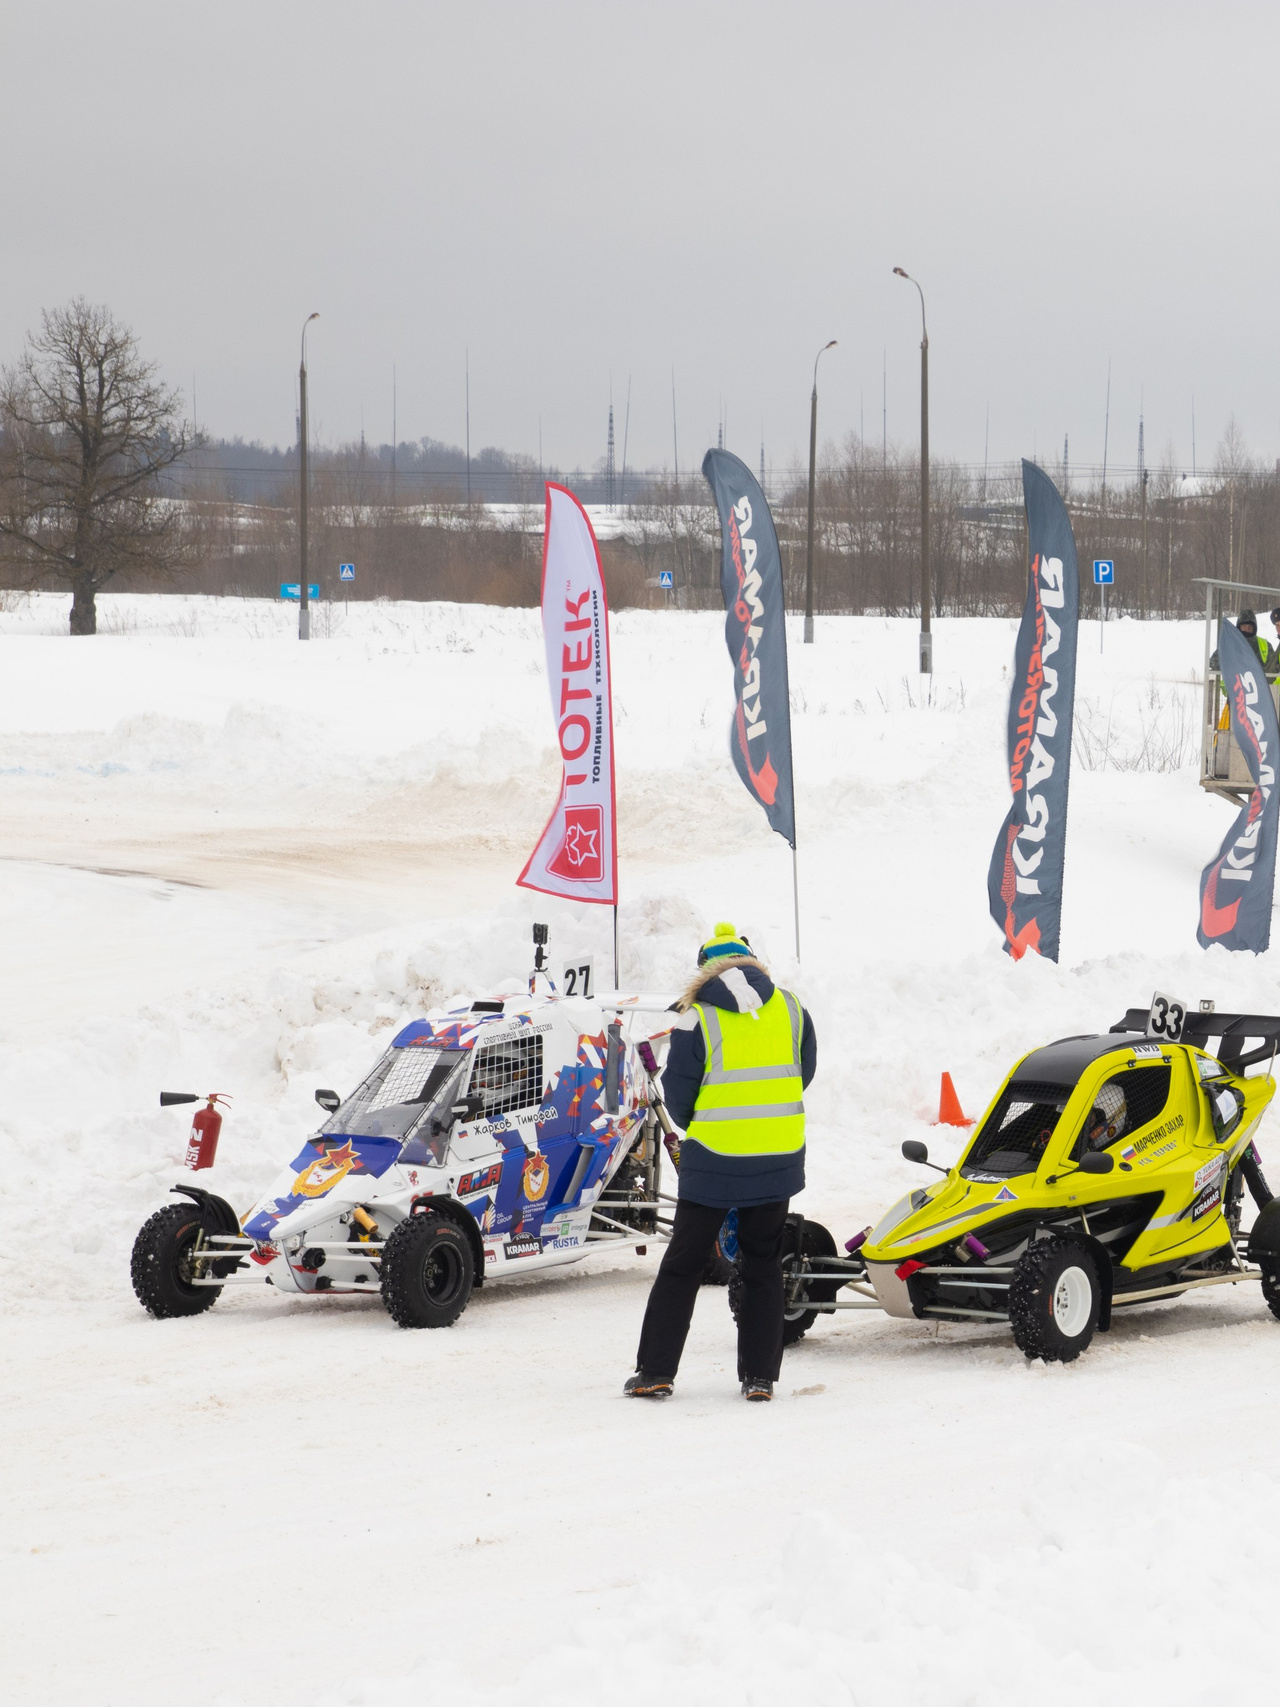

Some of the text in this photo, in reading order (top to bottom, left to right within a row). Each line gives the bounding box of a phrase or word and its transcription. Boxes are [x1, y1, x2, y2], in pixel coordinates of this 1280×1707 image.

[1099, 563, 1110, 582] P
[592, 589, 602, 784] ТОПЛИВНЫЕ ТЕХНОЛОГИИ
[564, 965, 590, 997] 27
[1151, 997, 1184, 1040] 33
[1132, 1045, 1160, 1054] NWB
[473, 1106, 558, 1136] Жарков Тимофей
[1133, 1114, 1185, 1154] МАРЧЕНКО ЗАХАР
[1194, 1190, 1220, 1217] KRAMAR
[496, 1215, 513, 1225] GROUP
[506, 1241, 541, 1255] KRAMAR
[553, 1236, 580, 1249] RUSTA
